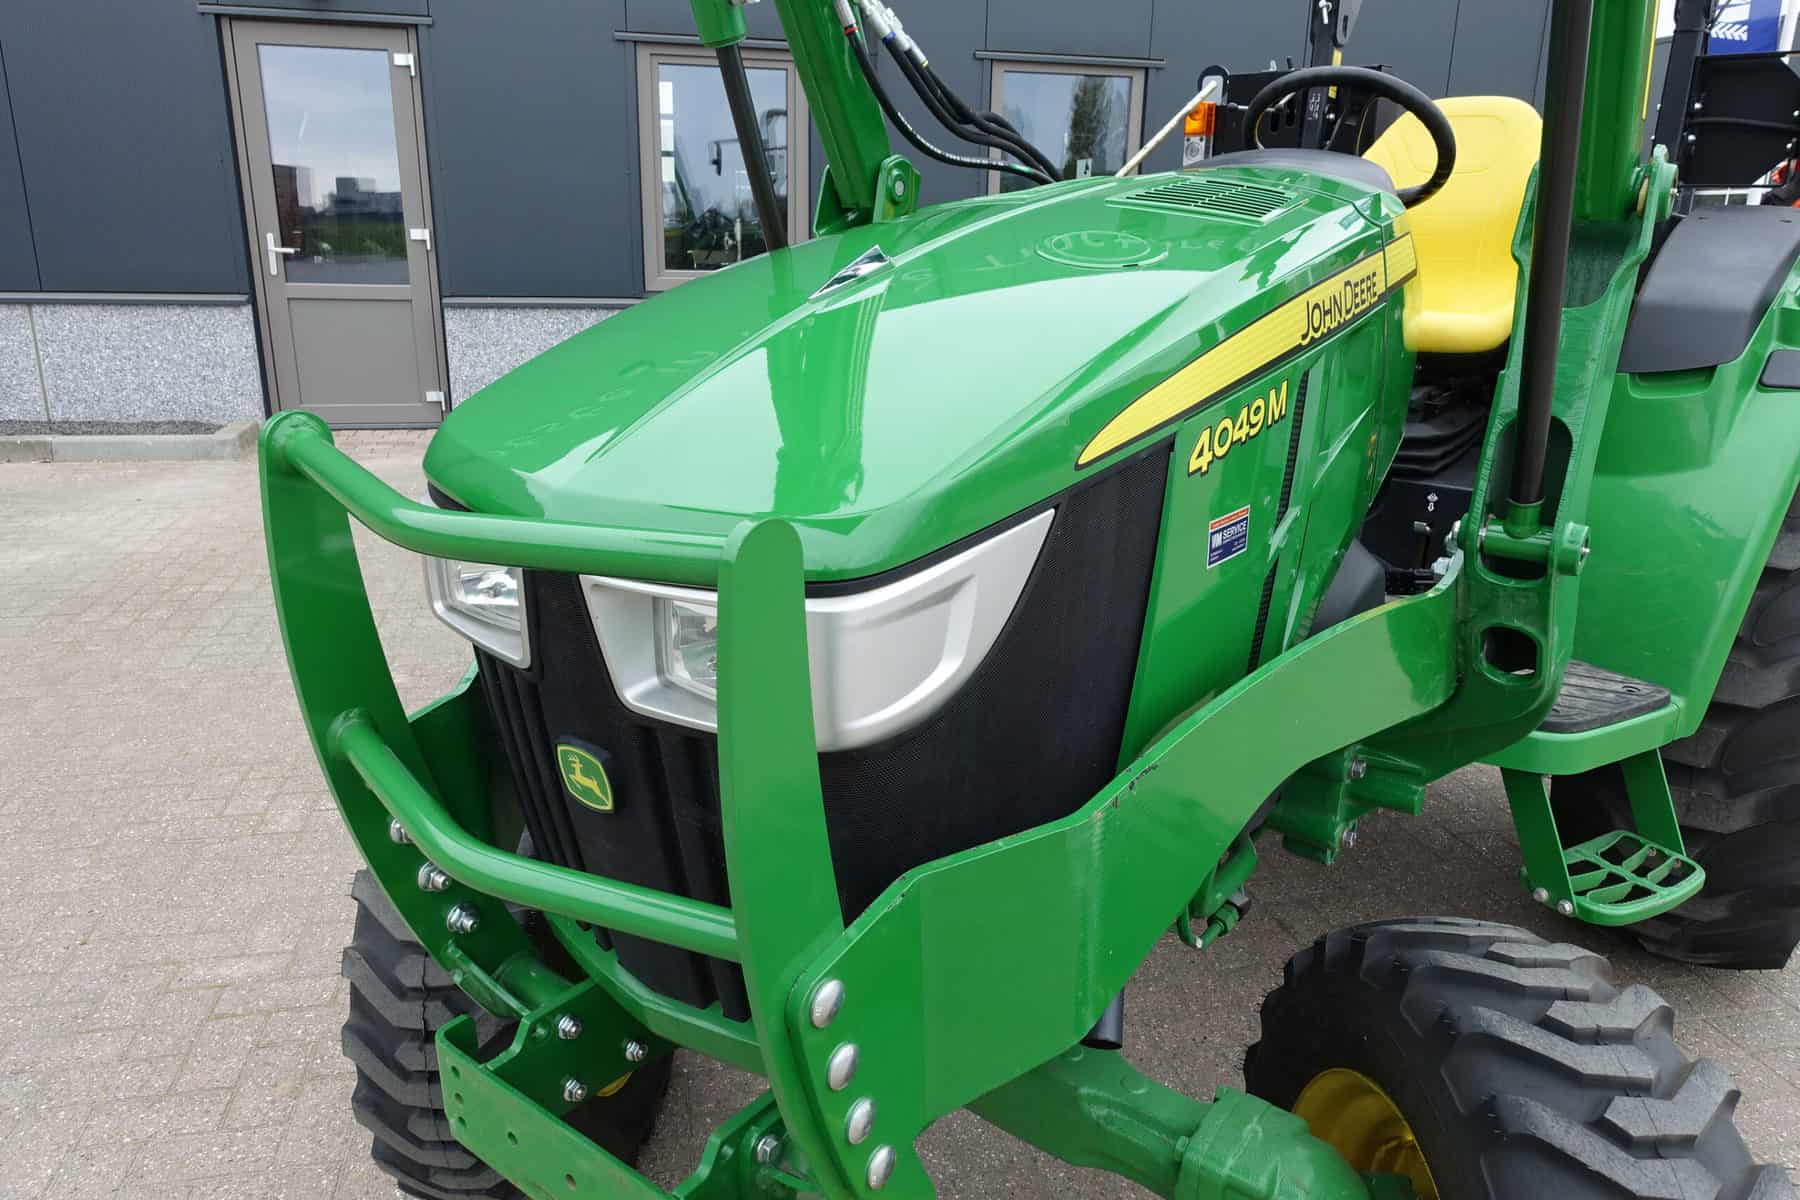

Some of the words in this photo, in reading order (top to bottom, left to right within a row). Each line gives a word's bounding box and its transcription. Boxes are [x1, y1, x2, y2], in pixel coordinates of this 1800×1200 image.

[1300, 299, 1343, 342] JOHN
[1343, 271, 1378, 318] DEERE
[1223, 520, 1247, 540] SERVICE
